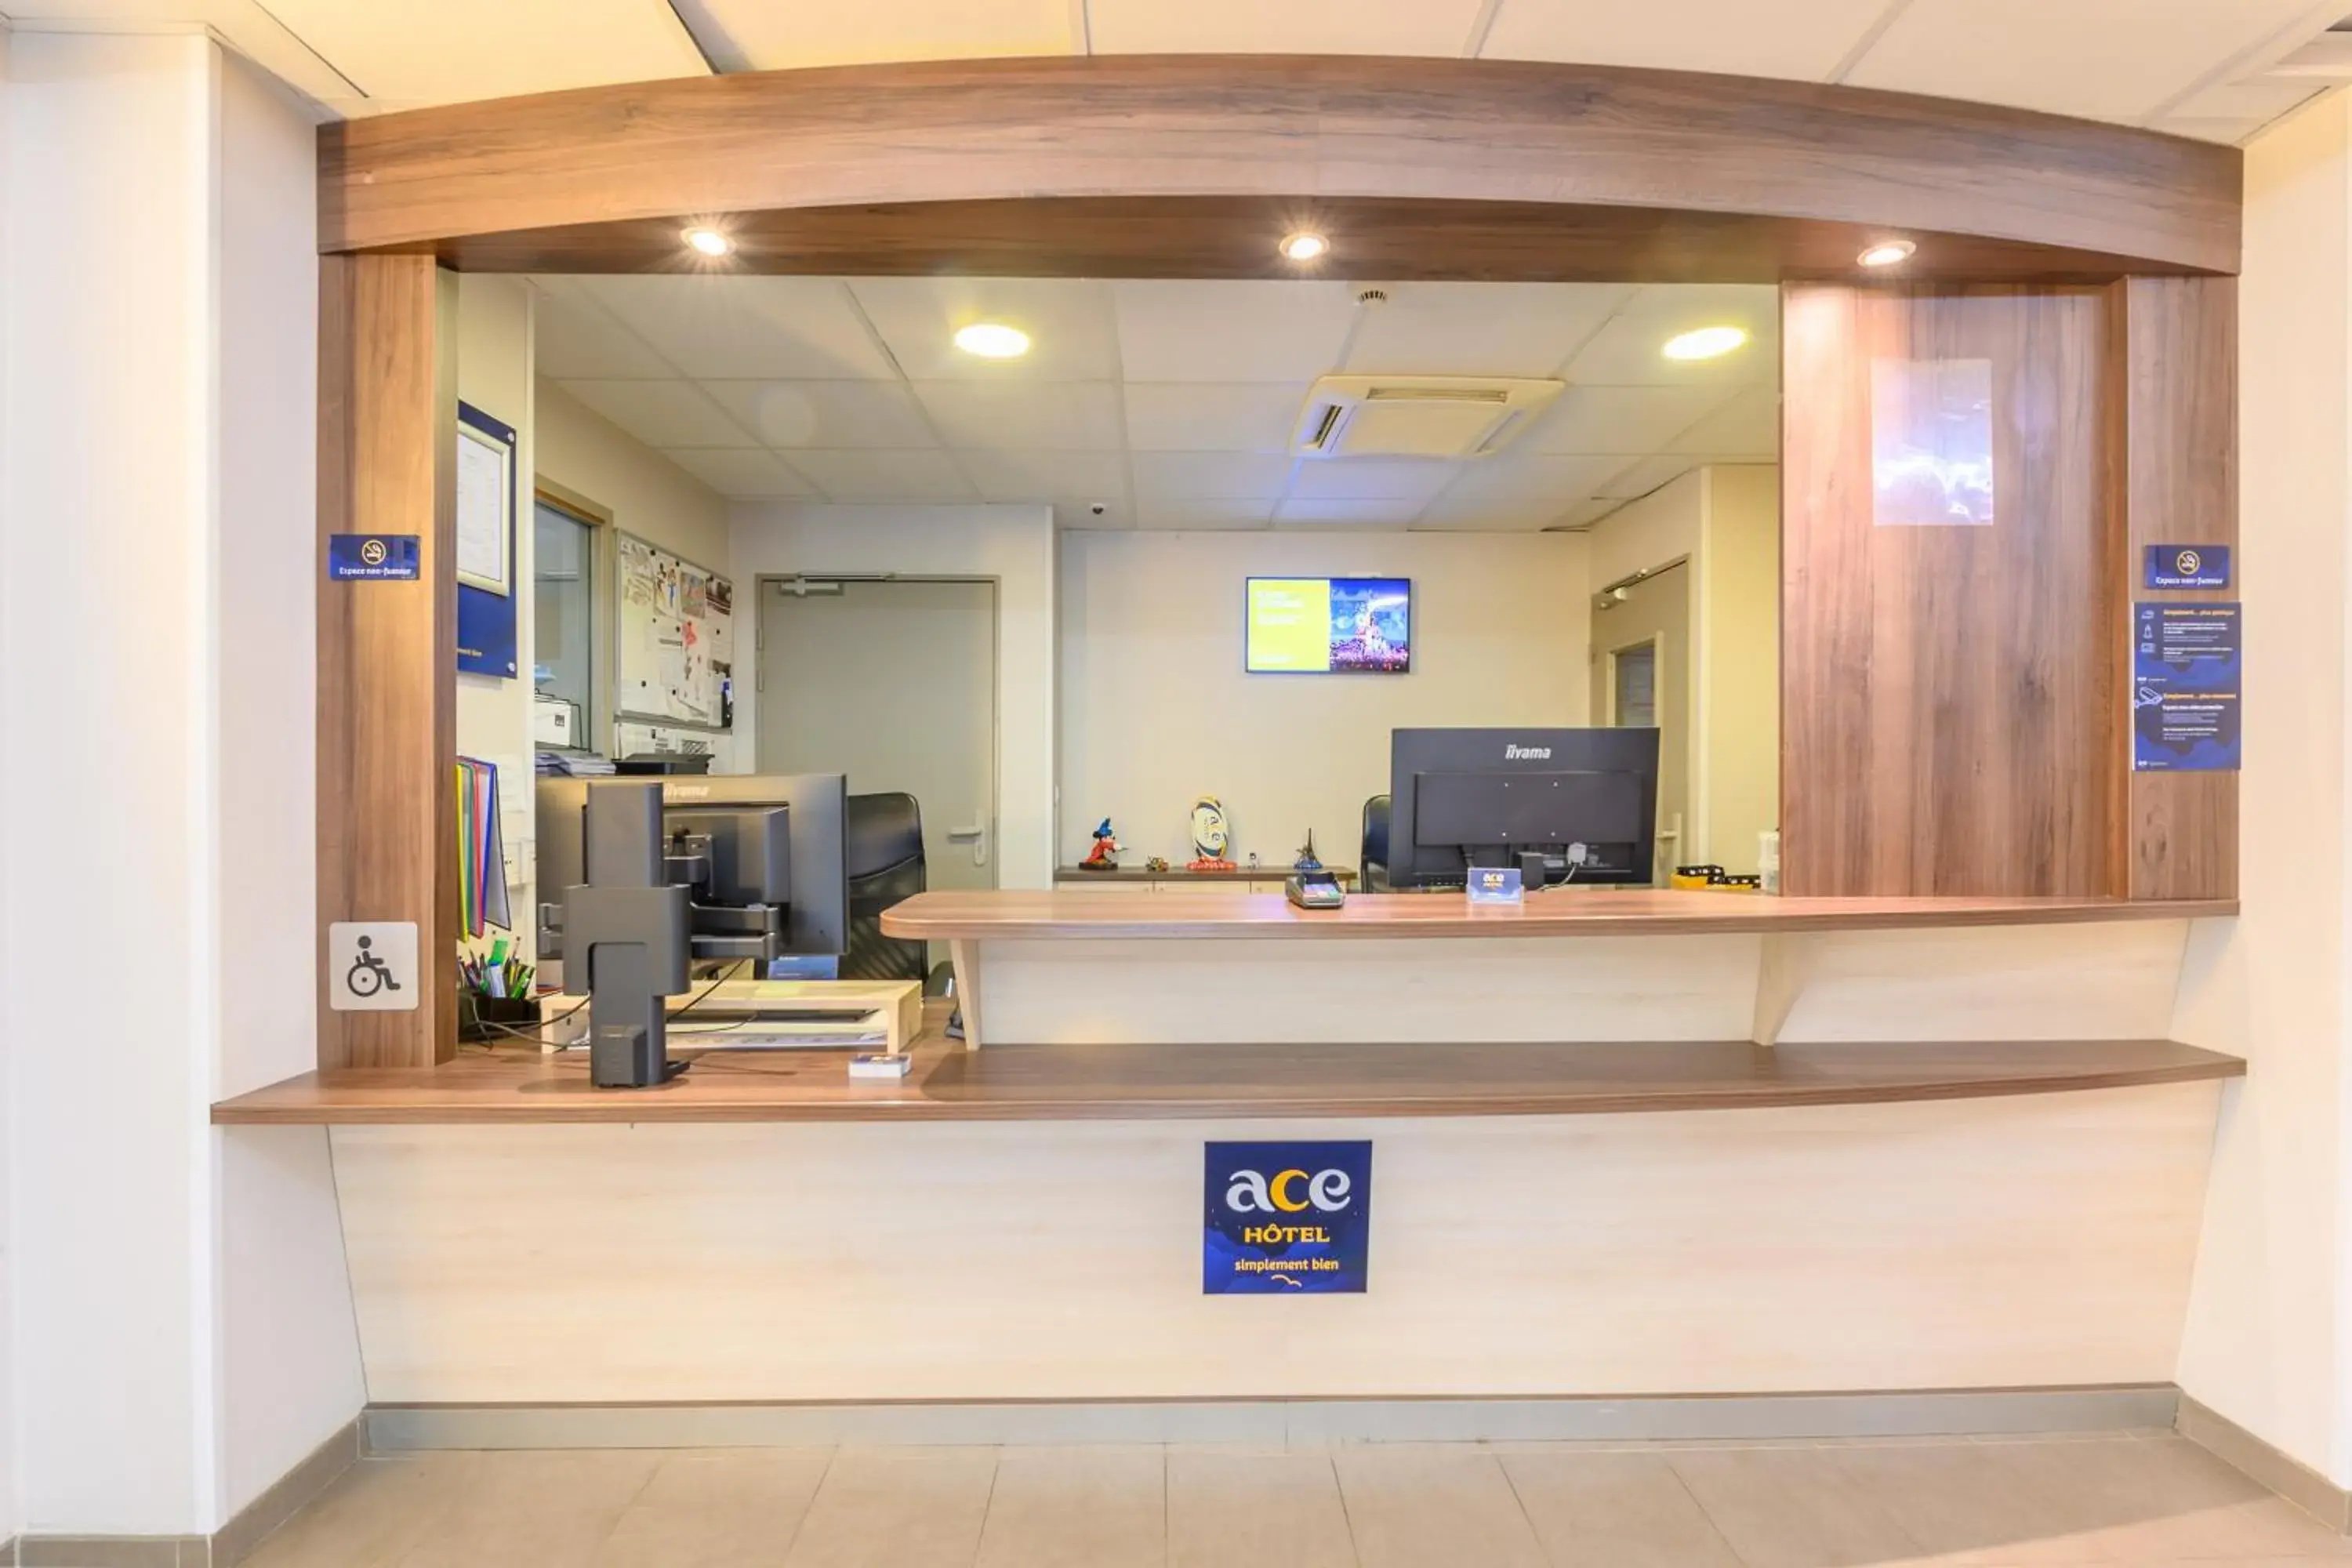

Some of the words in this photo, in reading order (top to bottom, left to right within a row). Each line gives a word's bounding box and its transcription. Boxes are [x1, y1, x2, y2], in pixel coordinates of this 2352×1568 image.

[339, 567, 365, 576] Espace
[366, 567, 412, 576] non-fumeur
[1225, 1168, 1351, 1213] ace
[1244, 1223, 1330, 1243] HÔTEL
[1235, 1258, 1308, 1273] simplement
[1312, 1257, 1339, 1271] bien
